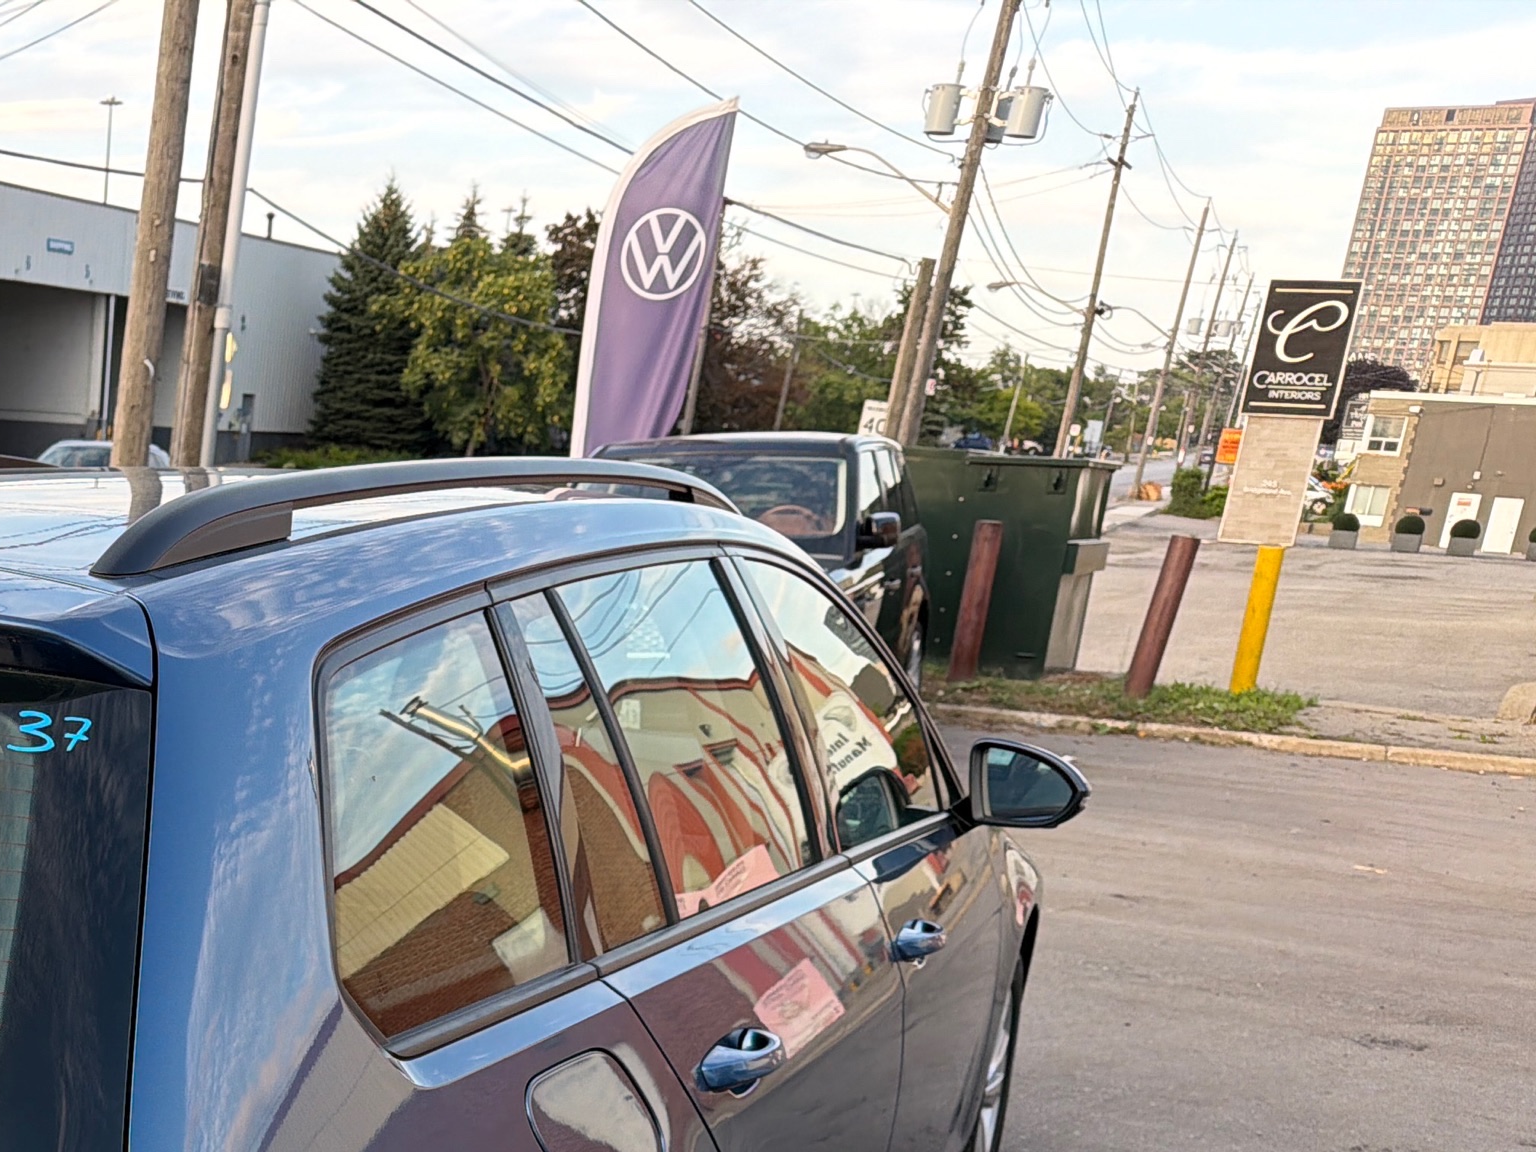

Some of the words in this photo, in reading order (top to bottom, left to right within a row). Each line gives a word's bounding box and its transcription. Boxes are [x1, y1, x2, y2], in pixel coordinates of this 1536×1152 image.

[1252, 370, 1333, 389] CARROCEL
[1268, 389, 1321, 401] INTERIORS
[7, 710, 92, 753] 37
